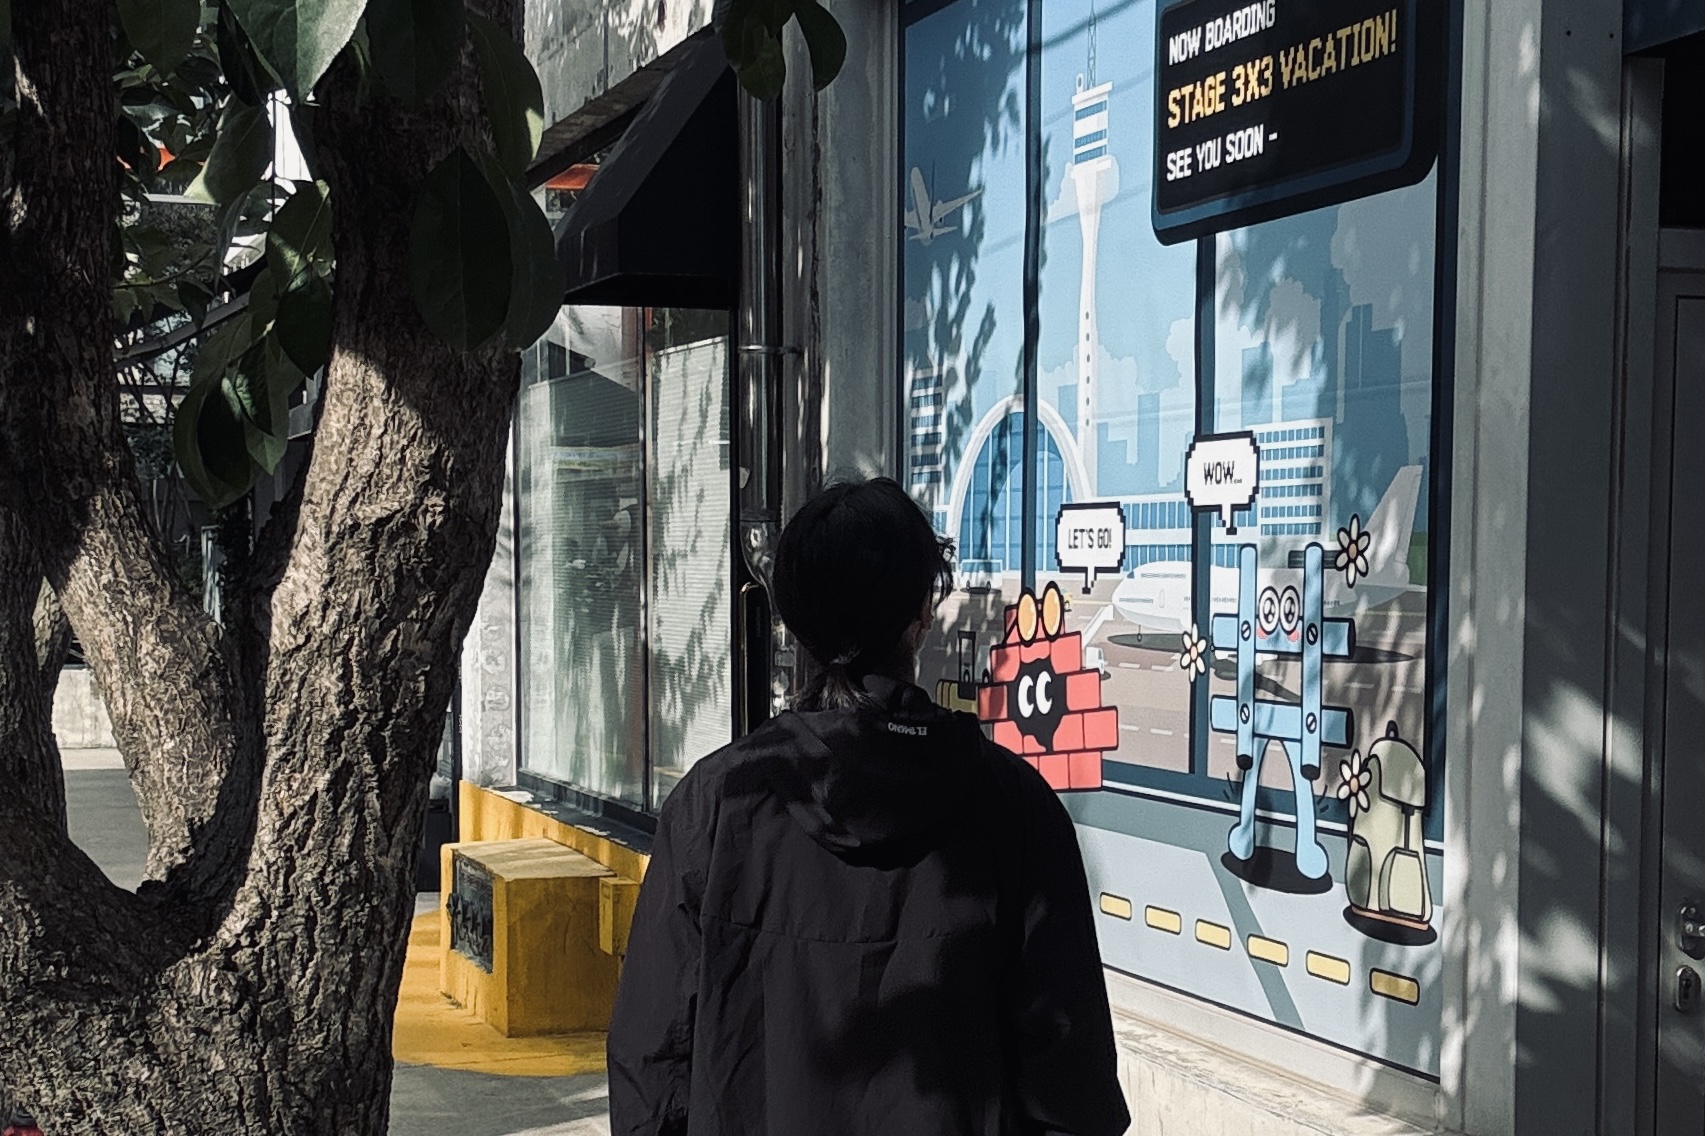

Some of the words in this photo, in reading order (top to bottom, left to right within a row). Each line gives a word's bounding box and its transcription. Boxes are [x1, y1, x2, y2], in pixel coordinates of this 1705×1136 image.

[1168, 26, 1202, 65] NOW
[1205, 0, 1276, 52] BOARDING
[1167, 71, 1226, 129] STAGE
[1231, 55, 1273, 106] 3X3
[1279, 9, 1397, 89] VACATION!
[1166, 147, 1192, 181] SEE
[1196, 137, 1221, 173] YOU
[1226, 124, 1264, 163] SOON
[1068, 528, 1094, 549] LET'S
[1098, 528, 1112, 549] GO!
